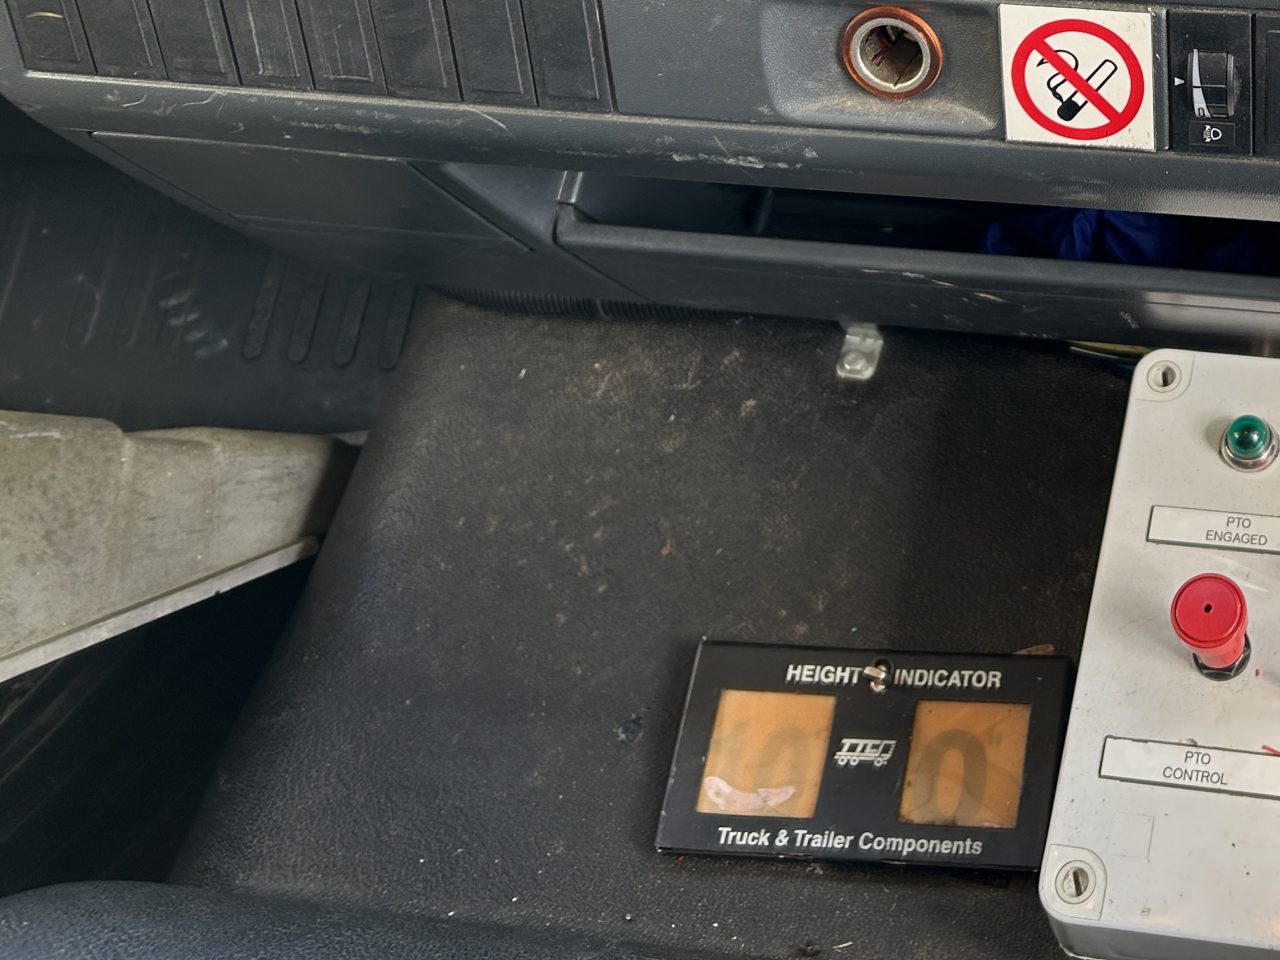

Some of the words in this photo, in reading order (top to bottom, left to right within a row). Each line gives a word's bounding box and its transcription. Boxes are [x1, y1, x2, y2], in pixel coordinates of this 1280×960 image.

[1226, 516, 1252, 529] PTO
[1205, 529, 1268, 546] ENGAGED
[786, 664, 863, 684] HEIGHT
[894, 668, 1002, 688] INDICATOR
[1184, 750, 1212, 765] PTO
[1162, 766, 1228, 786] CONTROL
[717, 826, 771, 846] Truck
[775, 829, 789, 847] &
[792, 829, 853, 849] Trailer
[858, 832, 983, 856] Components
